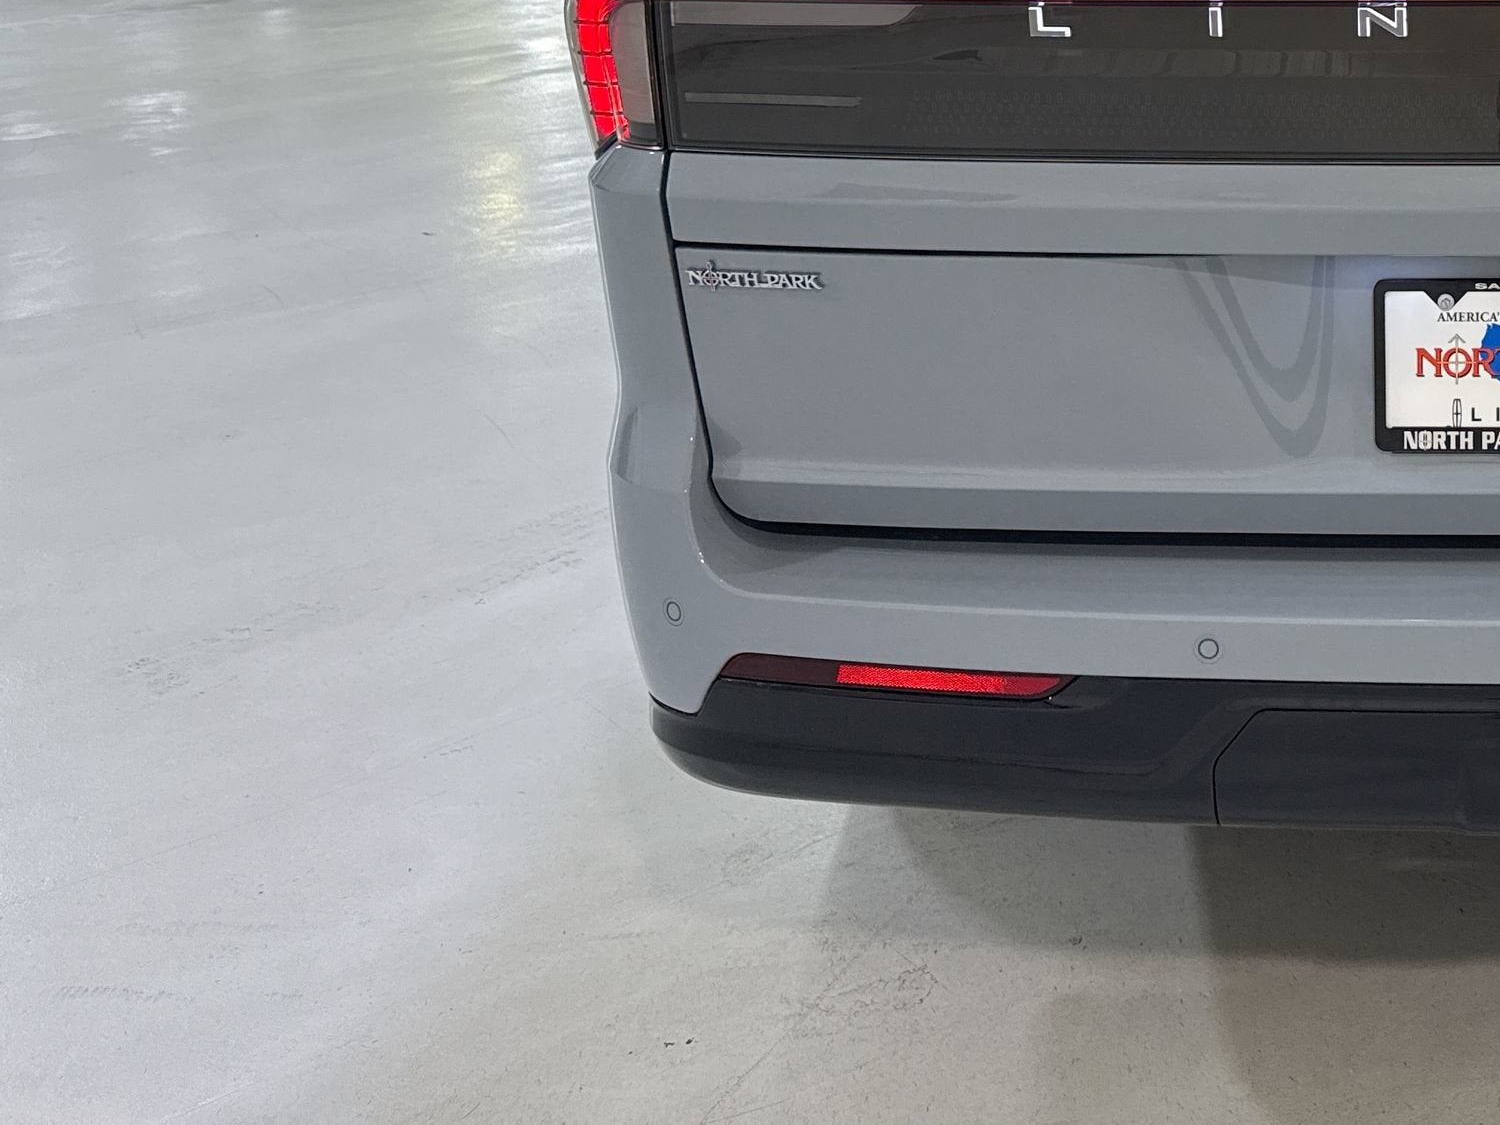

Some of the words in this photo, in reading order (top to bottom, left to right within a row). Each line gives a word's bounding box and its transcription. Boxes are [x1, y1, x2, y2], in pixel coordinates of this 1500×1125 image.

[685, 269, 760, 289] NORTH
[763, 272, 823, 290] PARK
[1403, 430, 1474, 451] NORTH
